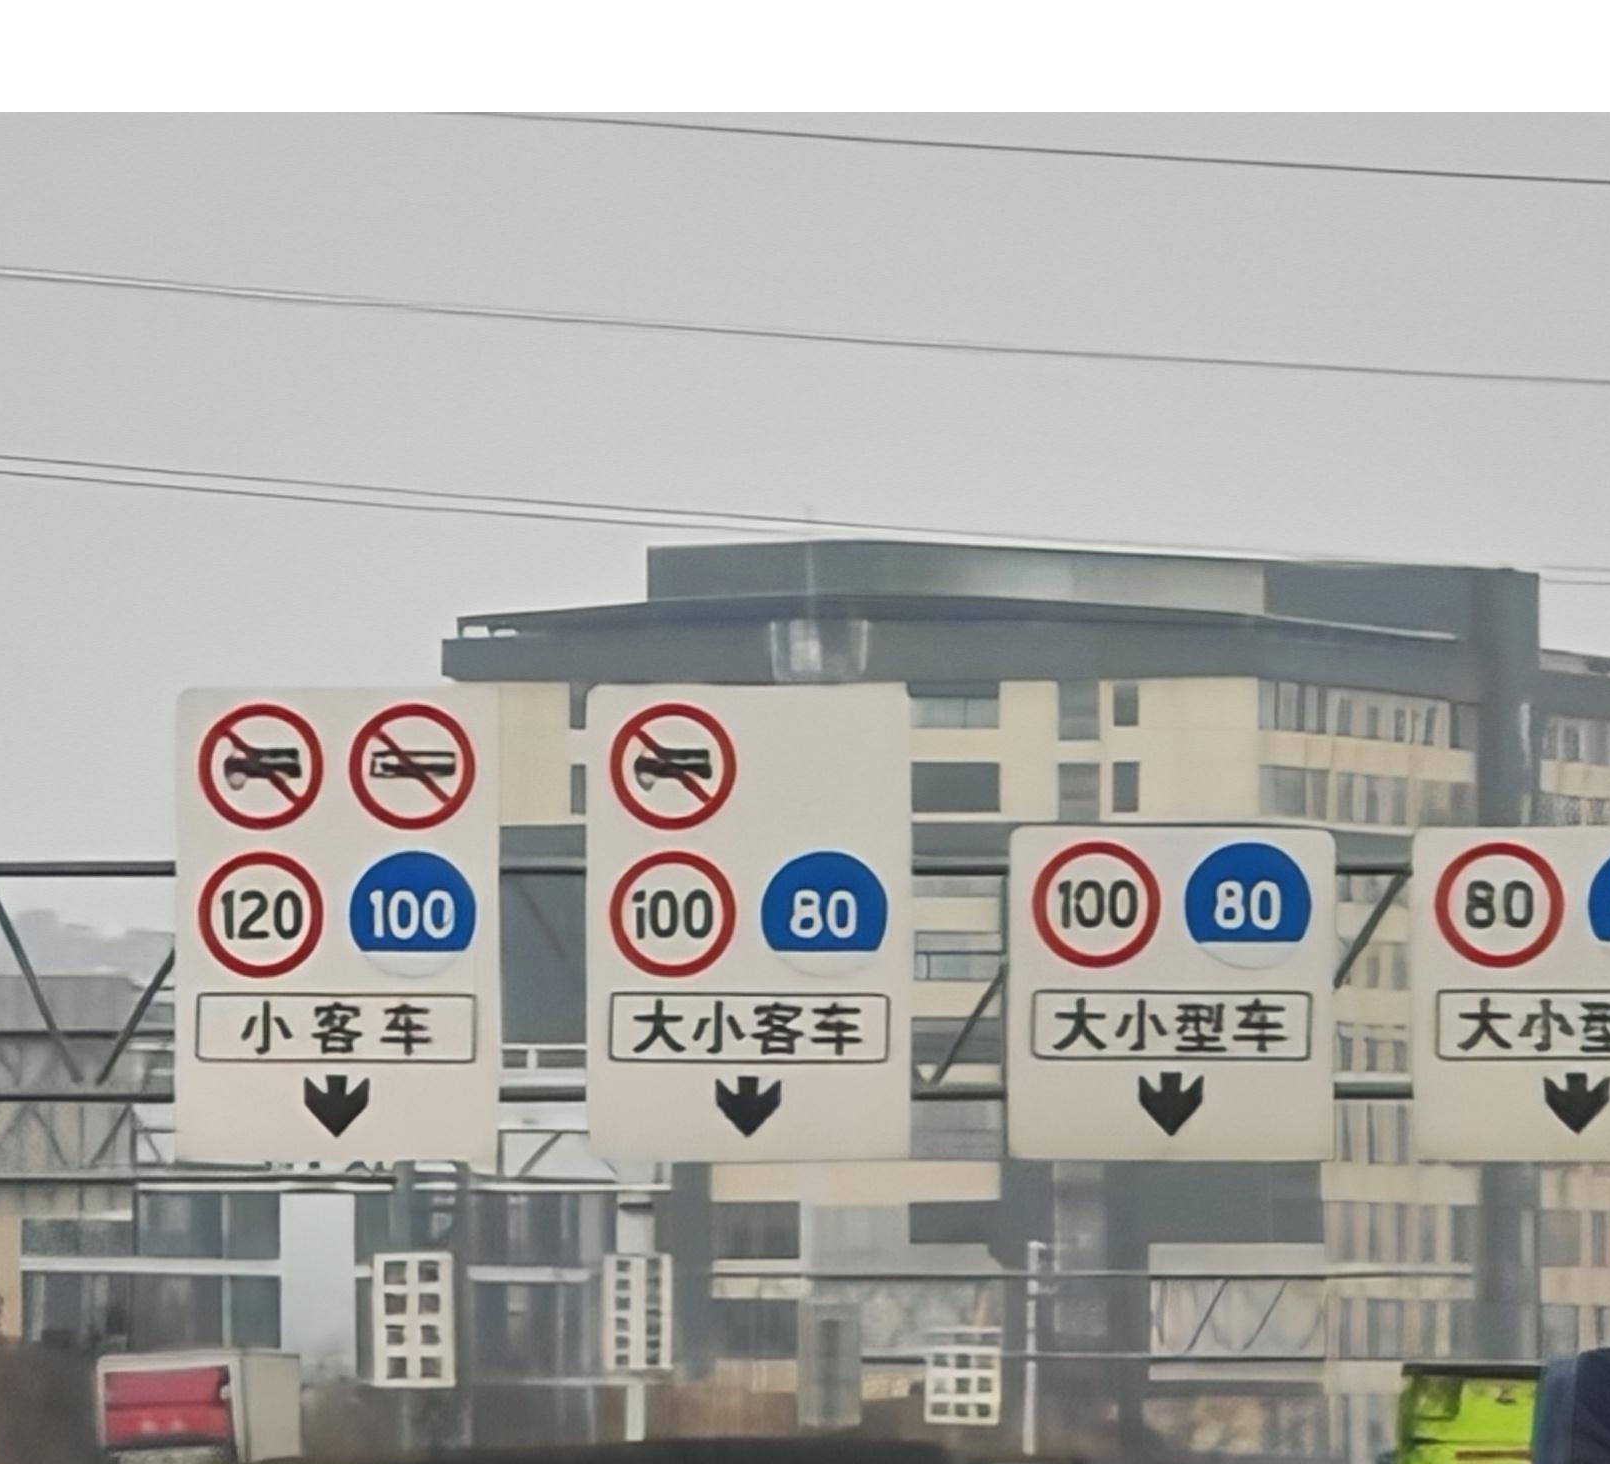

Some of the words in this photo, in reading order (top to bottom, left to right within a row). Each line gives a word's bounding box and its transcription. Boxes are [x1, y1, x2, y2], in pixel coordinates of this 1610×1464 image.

[221, 891, 303, 940] 120
[368, 890, 455, 940] 100
[633, 891, 713, 940] 100
[791, 890, 857, 938] 80
[1058, 880, 1138, 929] 100
[1215, 881, 1281, 930] 80
[1464, 880, 1534, 929] 80
[242, 1001, 432, 1055] 小客车
[633, 1000, 863, 1056] 大小客车
[1052, 997, 1287, 1053] 大小型车
